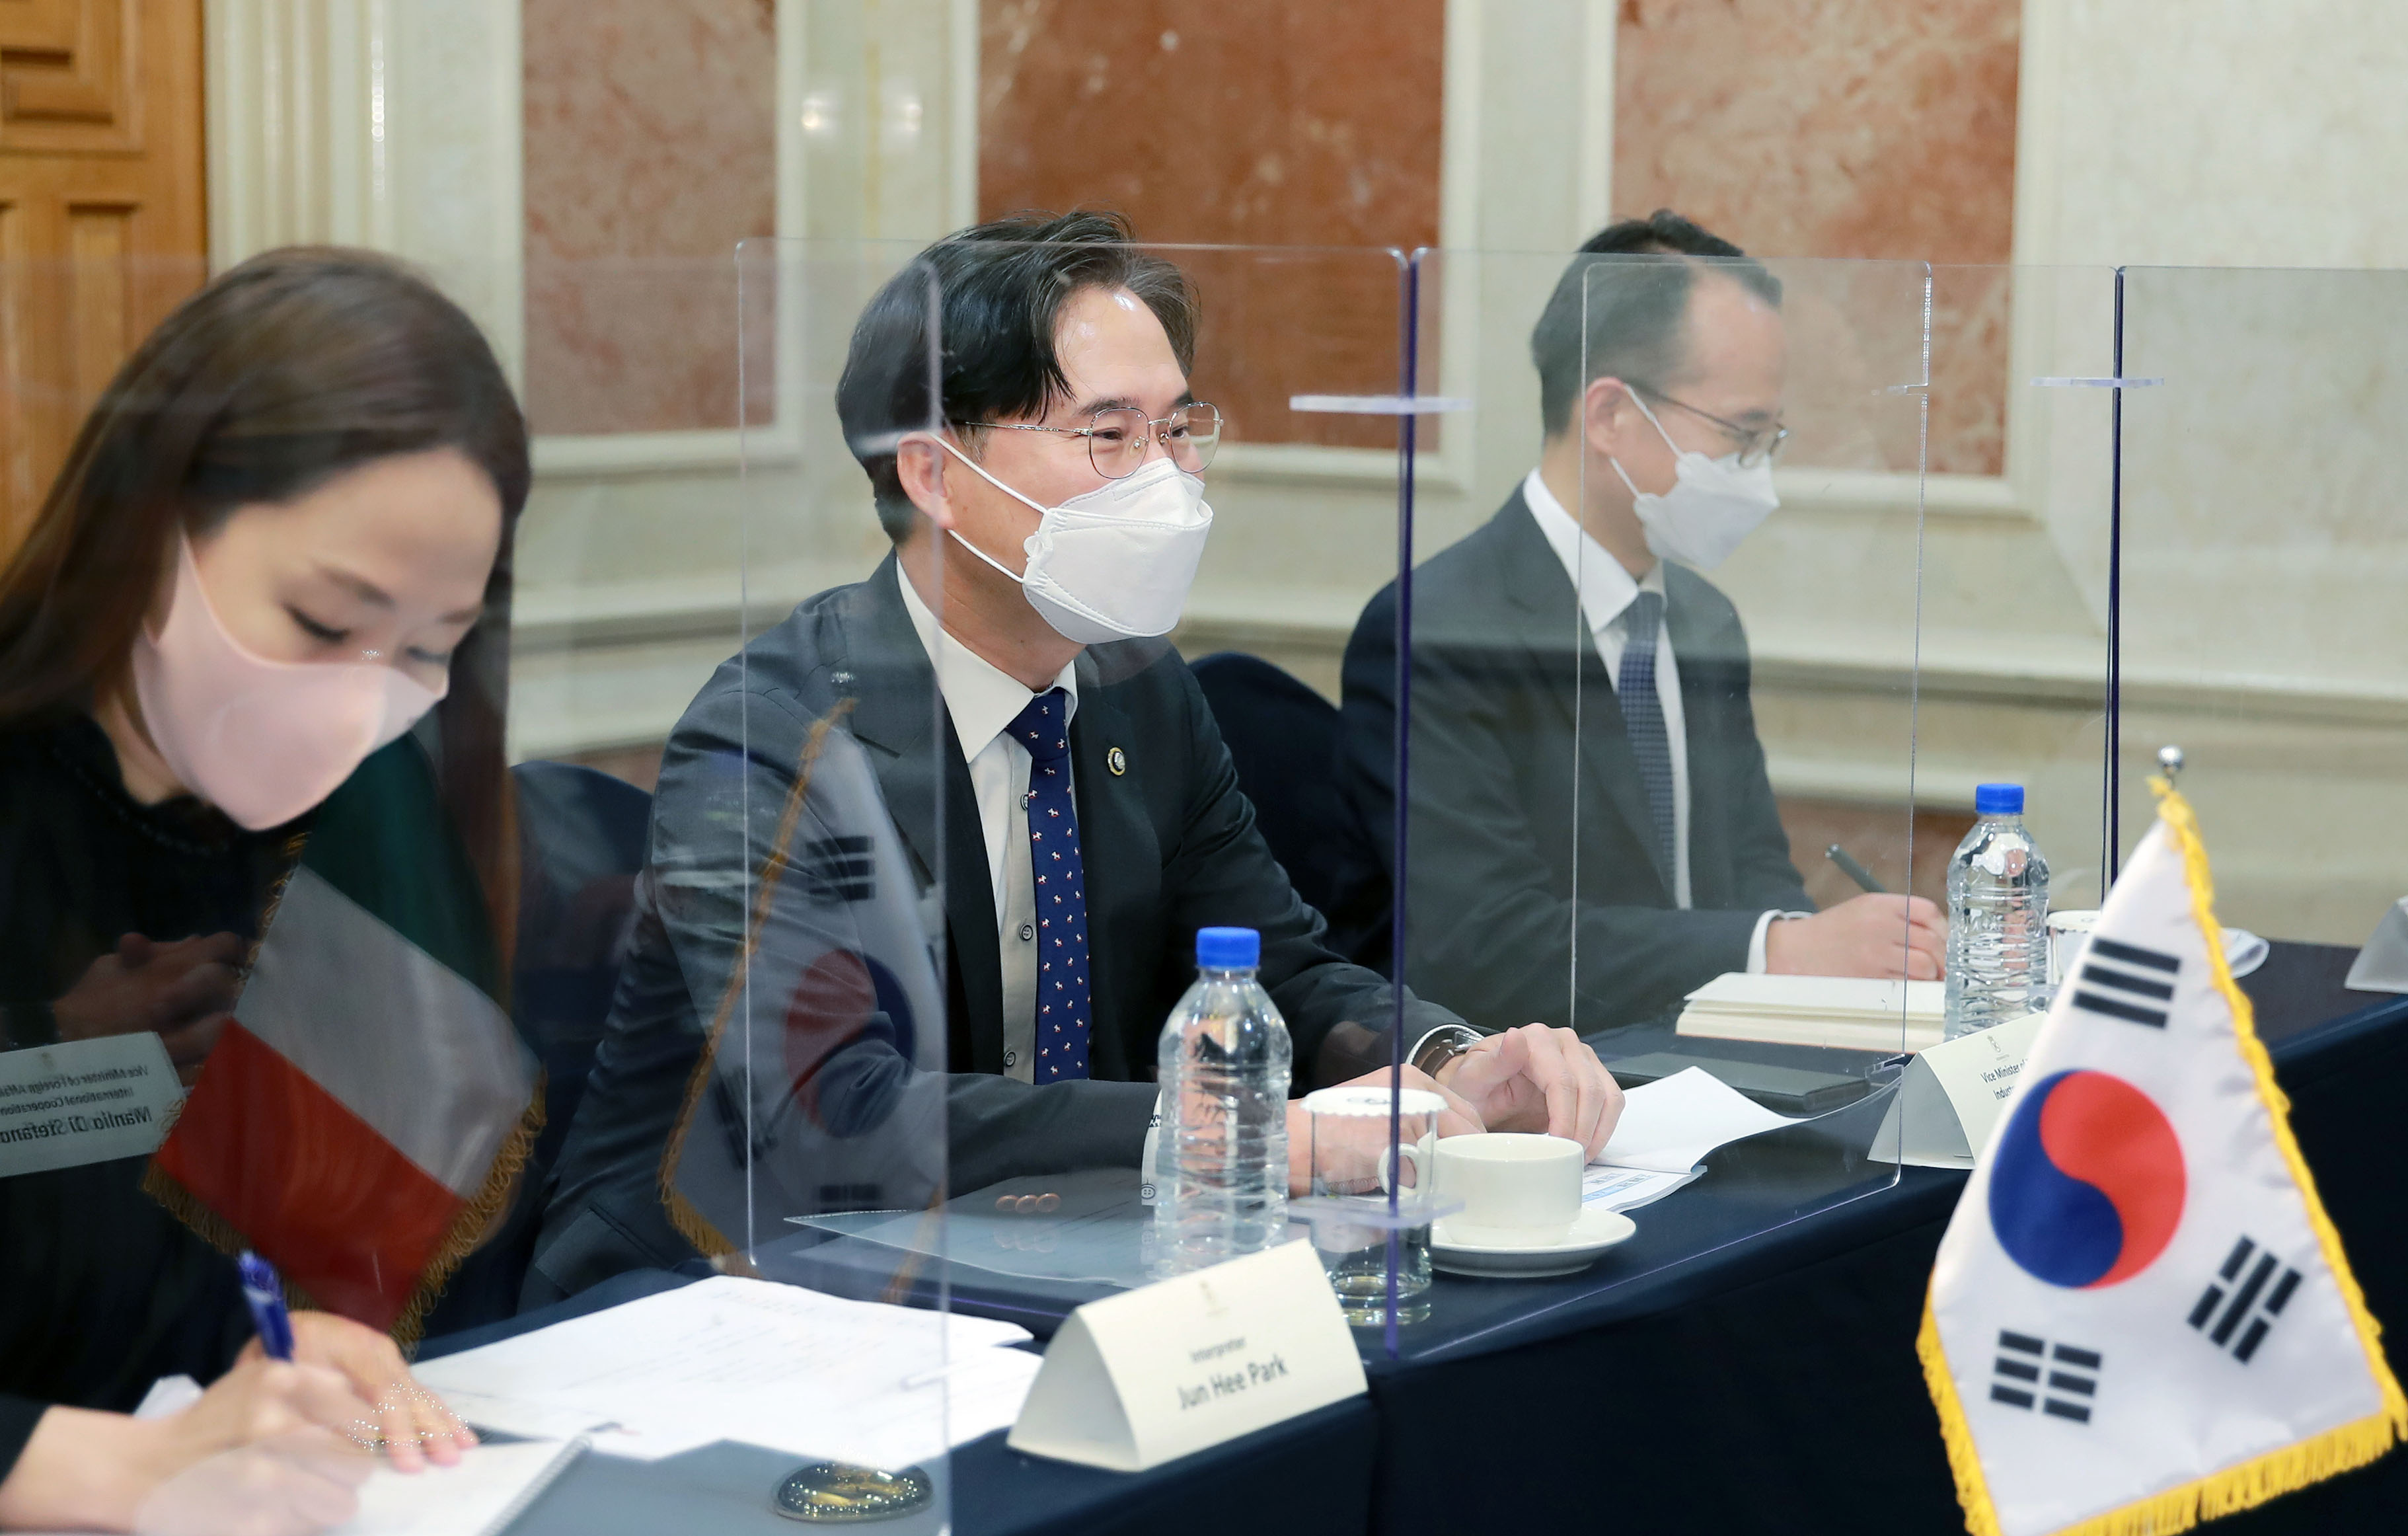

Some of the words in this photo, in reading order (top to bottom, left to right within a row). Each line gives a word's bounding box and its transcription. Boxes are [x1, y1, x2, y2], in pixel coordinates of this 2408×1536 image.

[1980, 1072, 1996, 1083] Vice
[1994, 1064, 2020, 1079] Minister
[1993, 1087, 2013, 1100] Indust
[1177, 1385, 1211, 1410] Jun
[1209, 1371, 1247, 1399] Hee
[1246, 1353, 1289, 1385] Park
